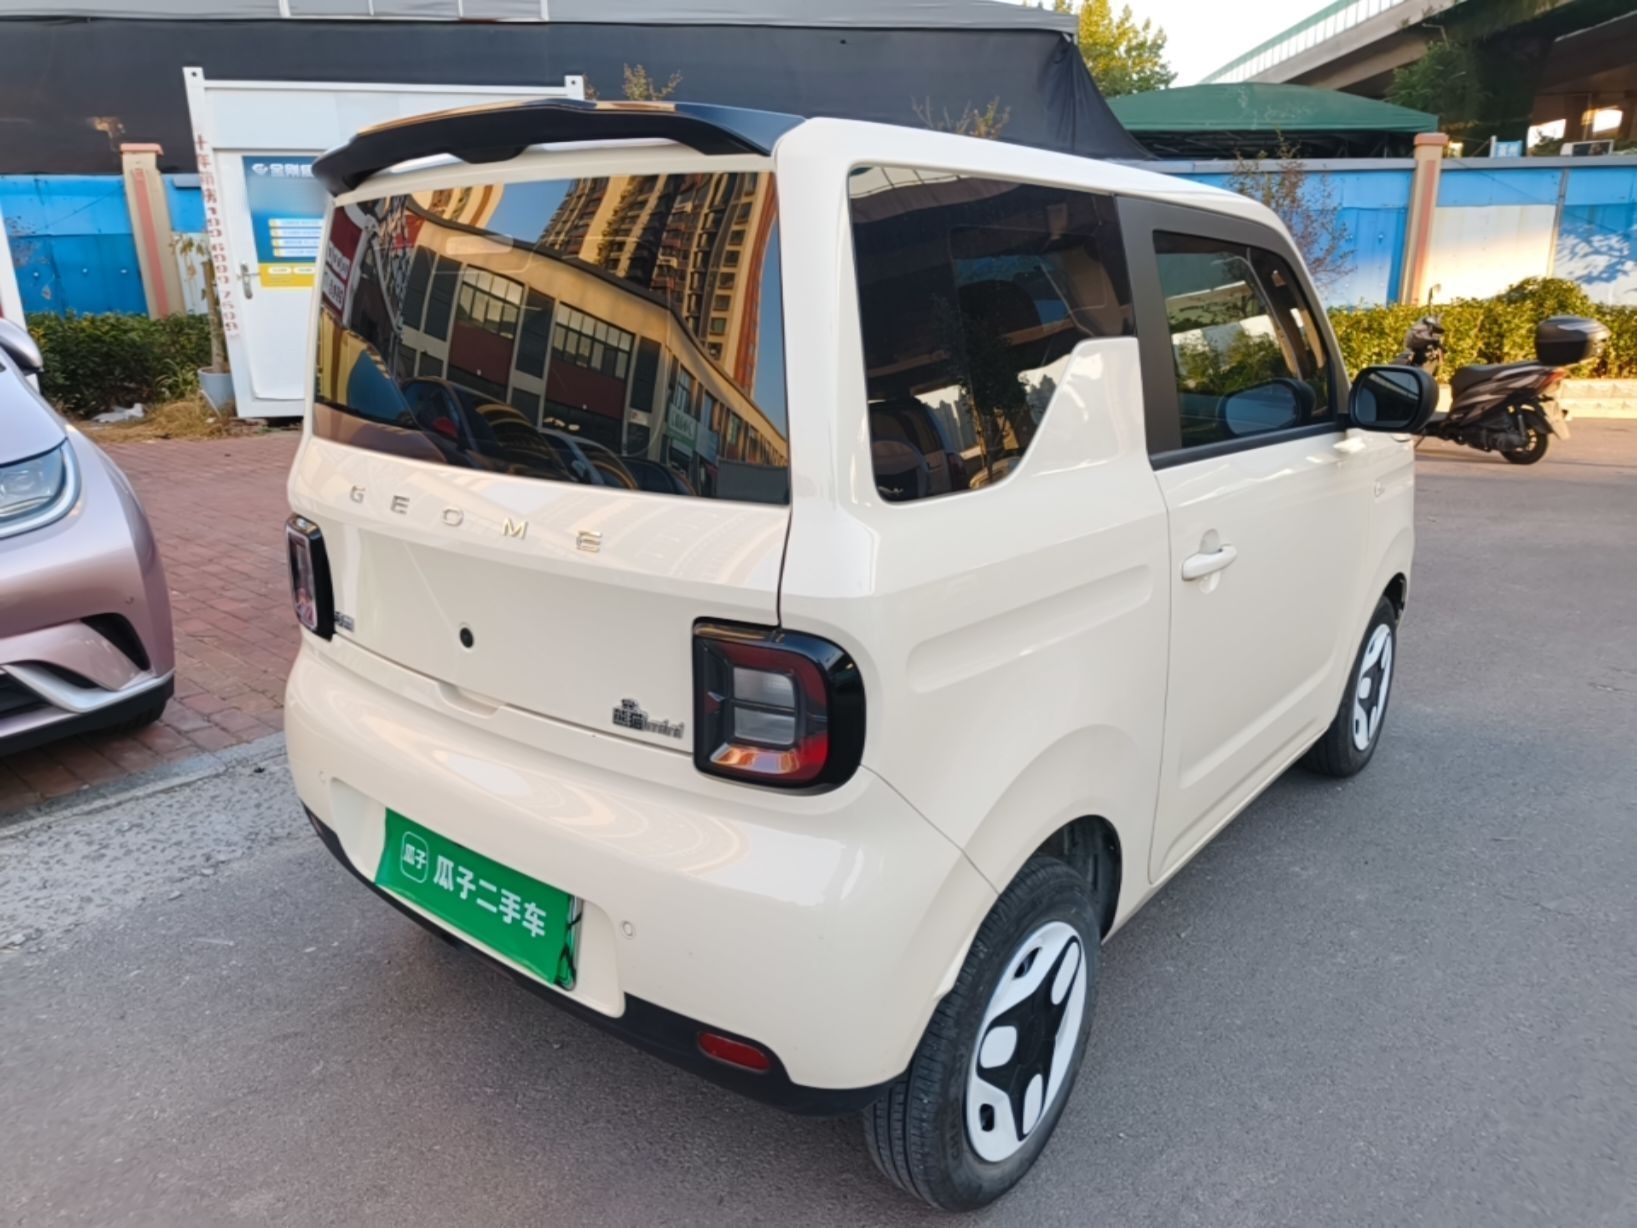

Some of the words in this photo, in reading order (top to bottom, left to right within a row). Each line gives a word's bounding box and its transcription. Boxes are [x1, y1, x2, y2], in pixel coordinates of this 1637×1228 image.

[349, 484, 603, 553] GEOME
[402, 842, 428, 870] 瓜子
[432, 854, 547, 938] 瓜子二手车
